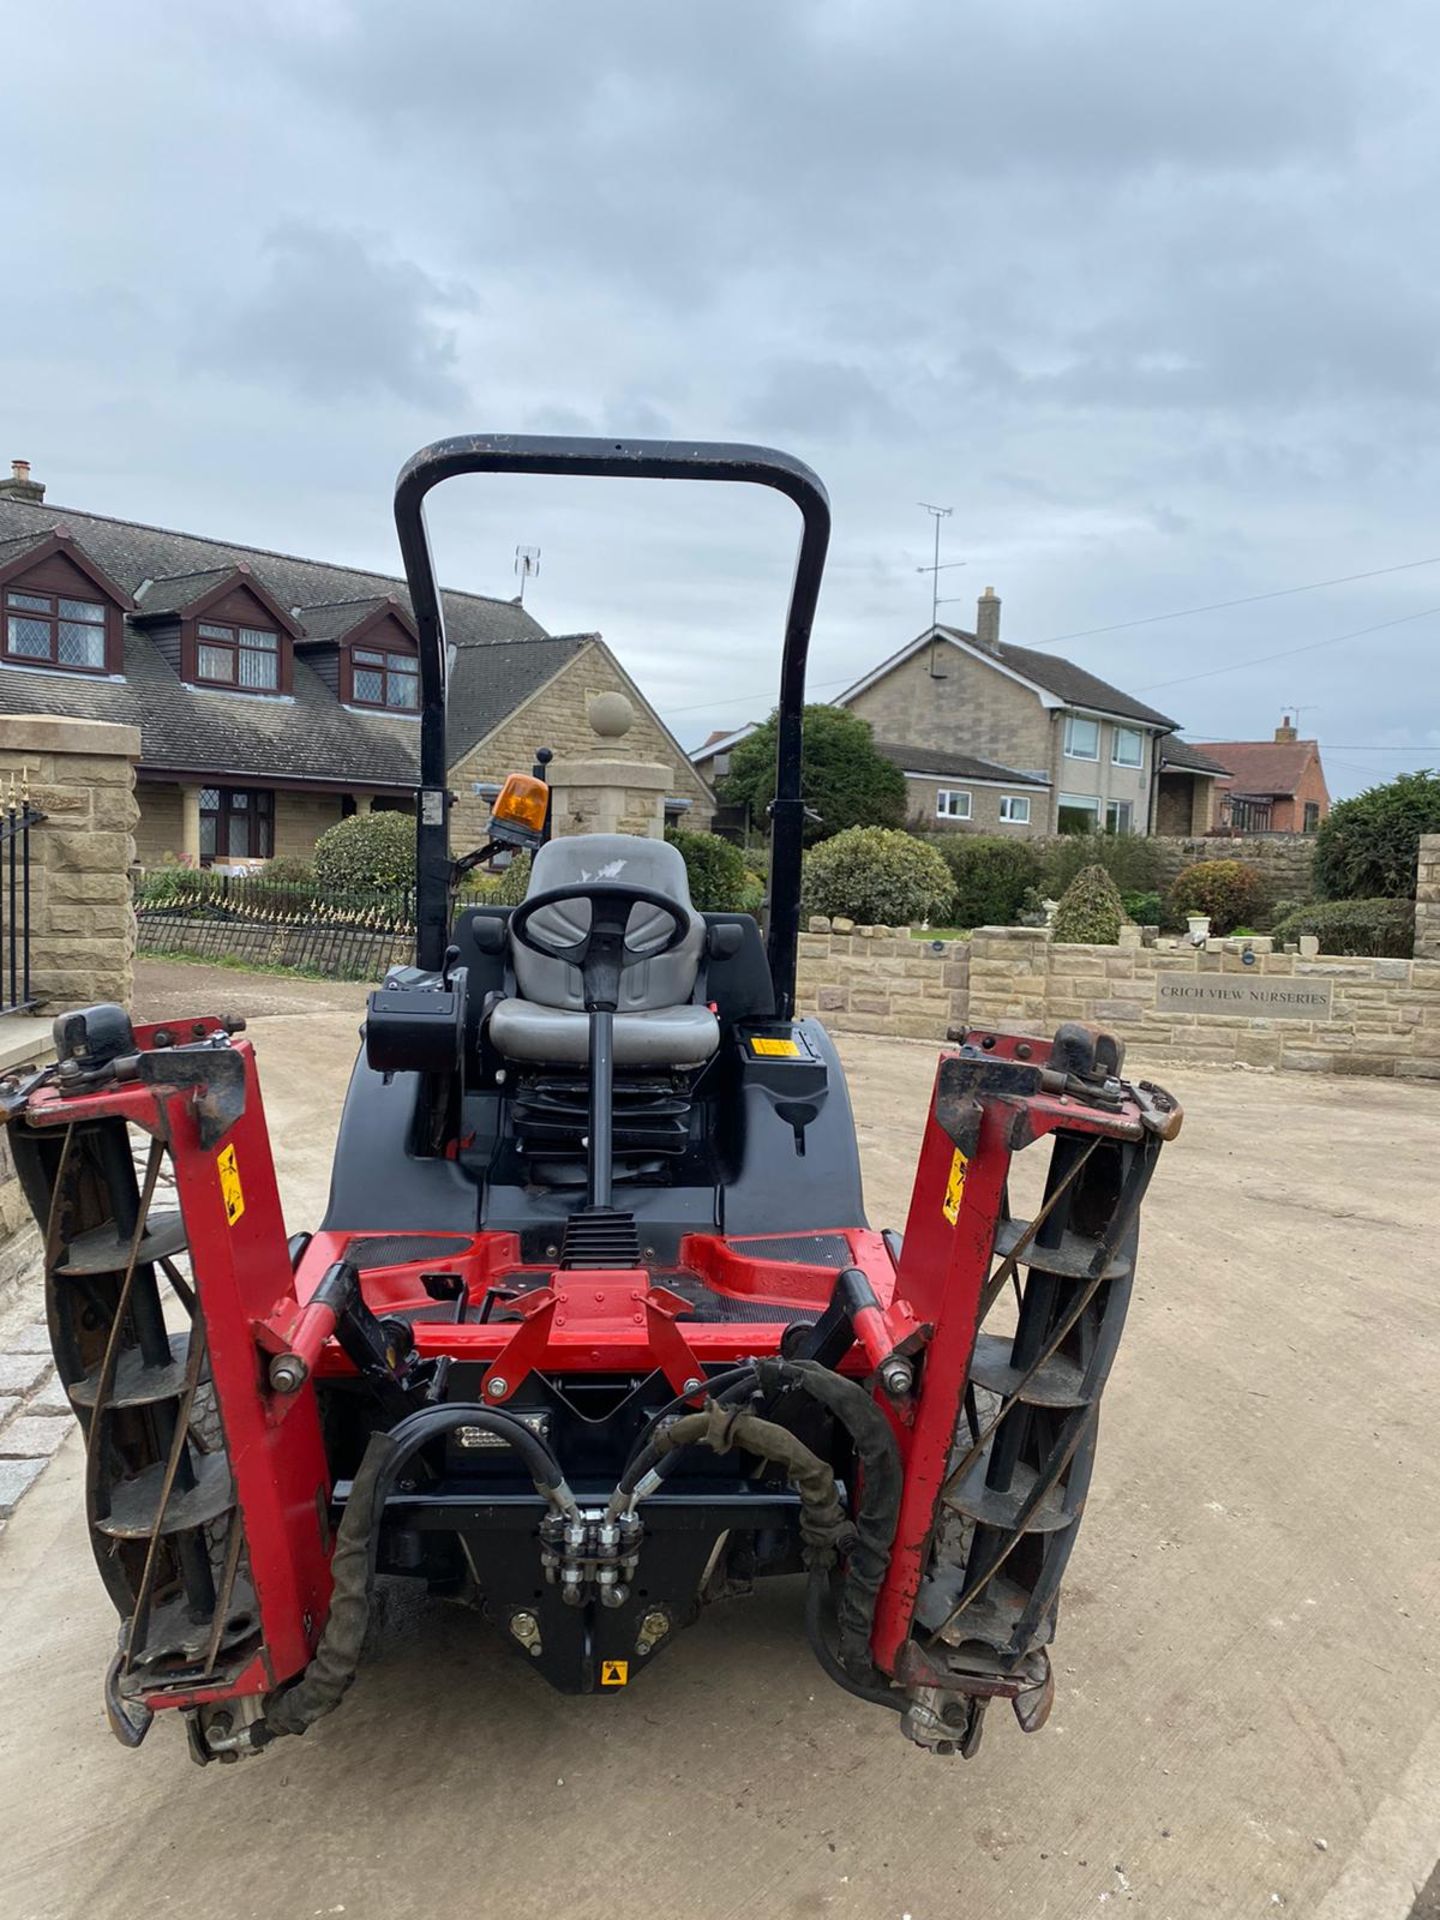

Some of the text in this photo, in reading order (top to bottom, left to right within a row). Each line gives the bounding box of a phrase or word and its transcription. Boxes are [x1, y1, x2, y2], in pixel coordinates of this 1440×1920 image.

[1161, 986, 1327, 1005] CRICH VIEW NURSERIES
